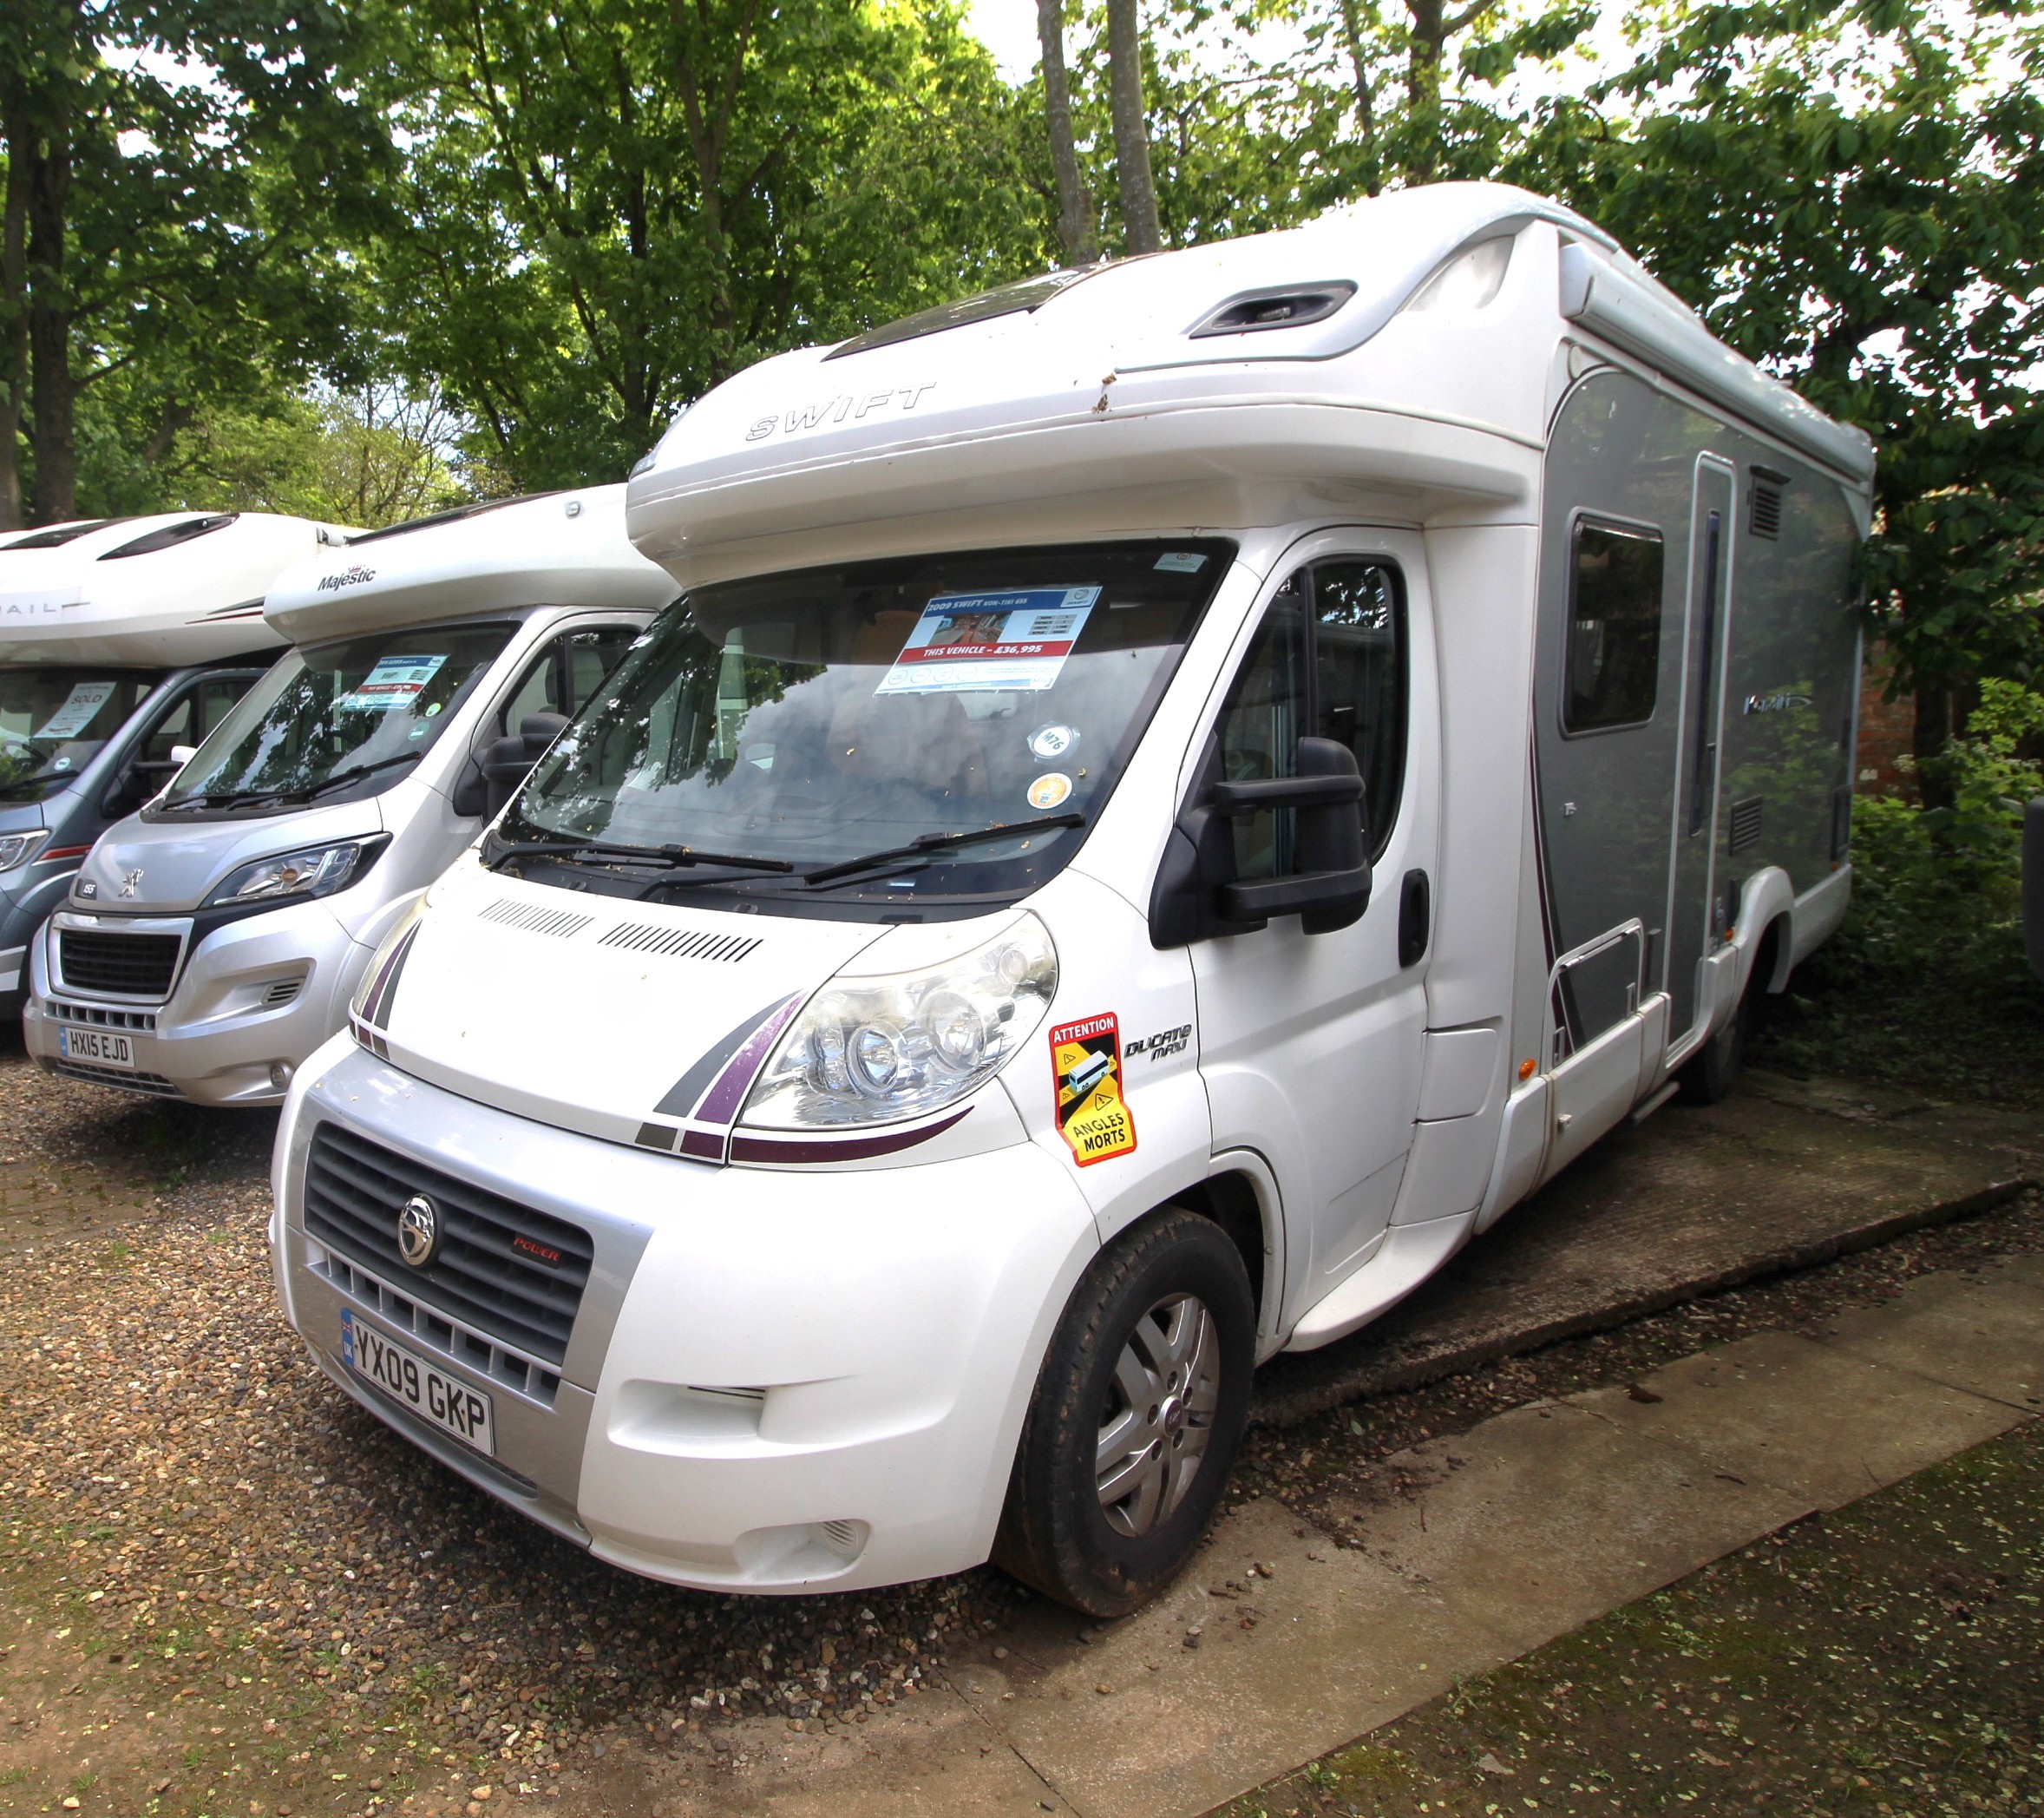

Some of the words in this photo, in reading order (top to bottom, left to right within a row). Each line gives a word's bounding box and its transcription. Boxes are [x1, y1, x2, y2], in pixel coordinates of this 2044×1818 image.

[745, 381, 938, 442] SWIFT
[317, 568, 377, 592] Majestic
[0, 603, 57, 614] AIL
[927, 601, 953, 612] 2009
[953, 599, 984, 609] SWIFT
[983, 598, 1014, 607] KON-TIKI
[923, 647, 945, 658] THIS
[946, 646, 986, 655] VEHICLE
[993, 645, 1043, 655] £36,995
[71, 694, 103, 706] SOLD
[1041, 731, 1065, 751] M76
[1052, 1016, 1115, 1044] ATTENTION
[1123, 1024, 1193, 1060] DUCATO
[70, 1031, 99, 1057] HX15
[101, 1035, 128, 1062] EJD
[1150, 1039, 1188, 1062] MAXI
[1072, 1112, 1125, 1139] ANGLES
[1083, 1128, 1126, 1152] MORTS
[513, 1237, 560, 1262] POWER
[355, 1324, 421, 1404] YX09
[427, 1373, 486, 1439] GKP
